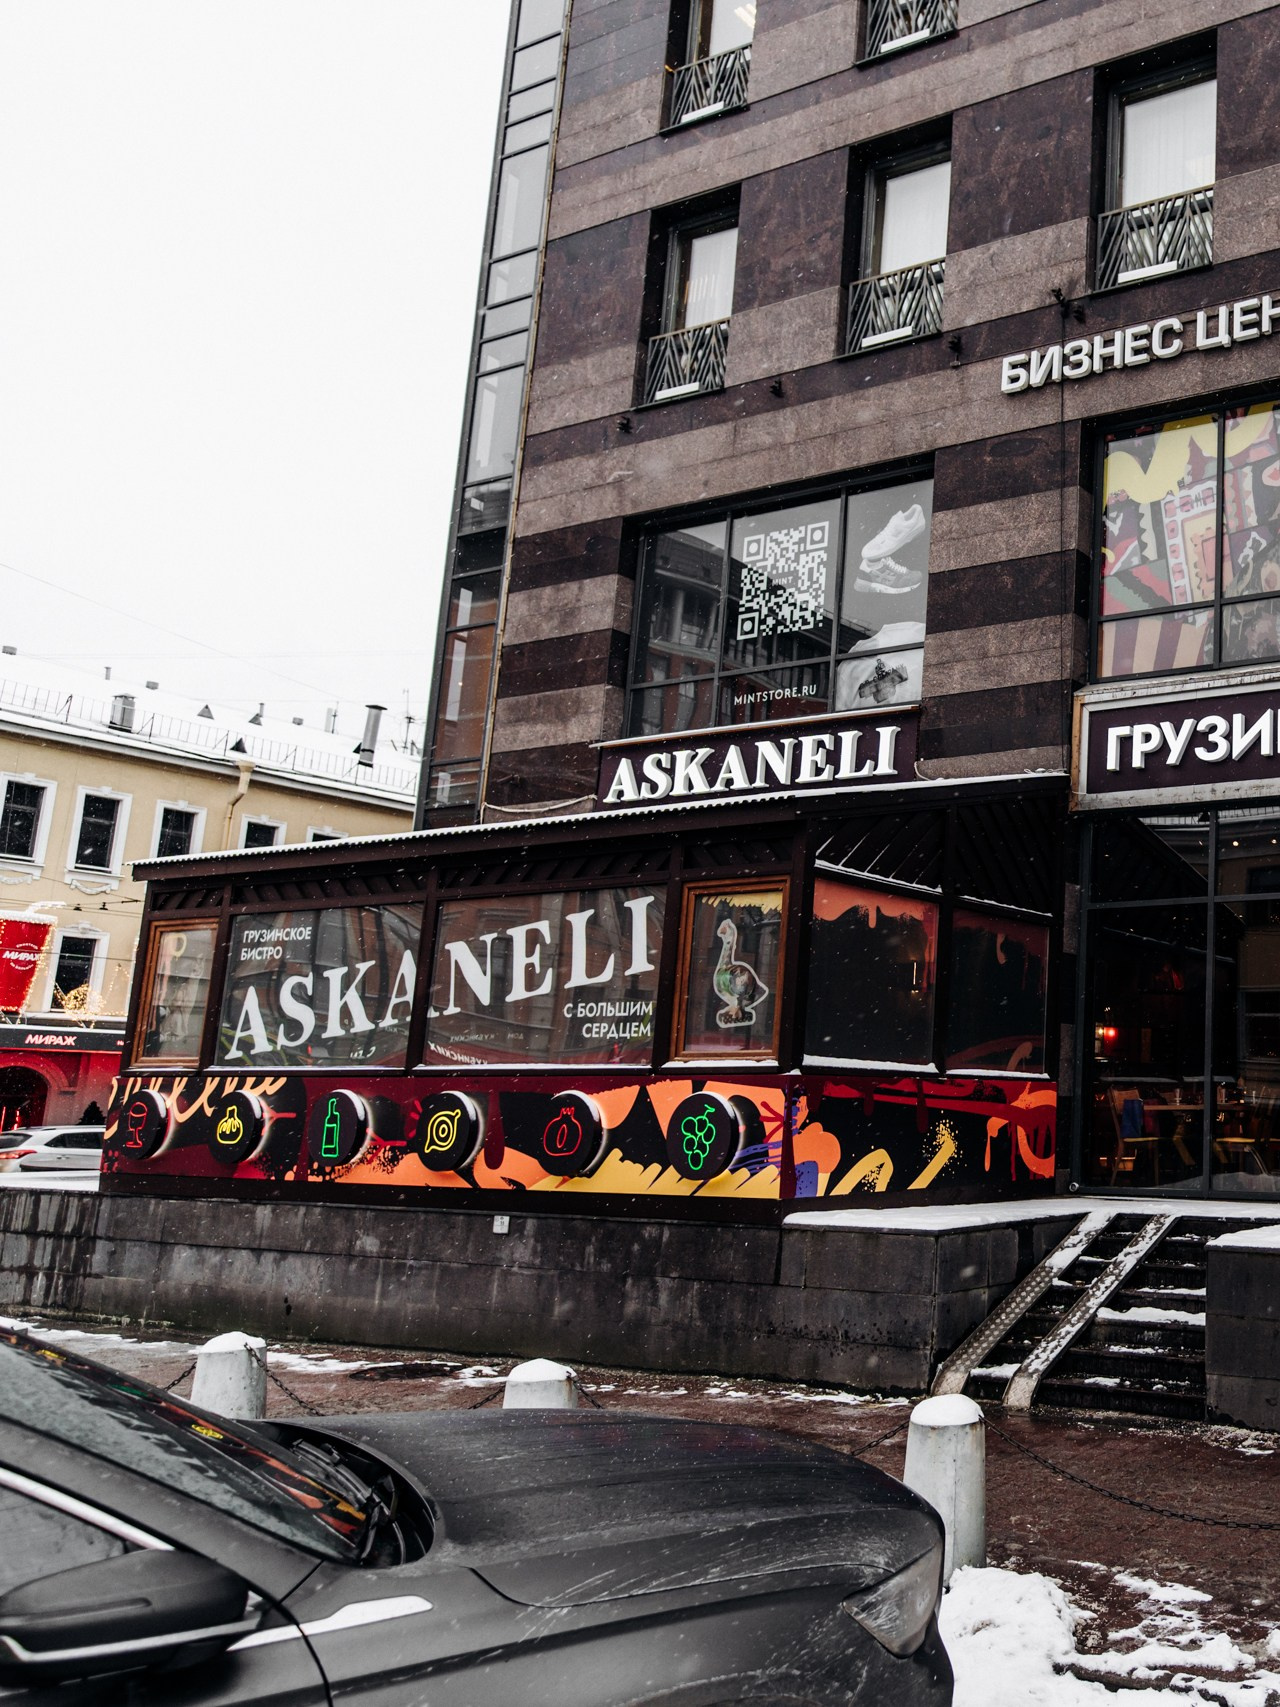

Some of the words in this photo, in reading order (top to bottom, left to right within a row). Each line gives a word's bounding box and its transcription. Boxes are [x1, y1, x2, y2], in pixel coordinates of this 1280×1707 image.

[1000, 316, 1184, 395] БИЗНЕС
[734, 684, 817, 706] MINTSTORE.RU
[602, 725, 901, 803] ASKANELI
[242, 926, 312, 943] ГРУЗИНСКОЕ
[240, 946, 283, 961] БИСТРО
[224, 895, 656, 1060] ASKANELI
[563, 1003, 573, 1018] С
[577, 1001, 654, 1018] БОЛЬШИМ
[25, 1034, 77, 1046] МИРАЖ
[582, 1022, 652, 1040] СЕРДЦЕМ
